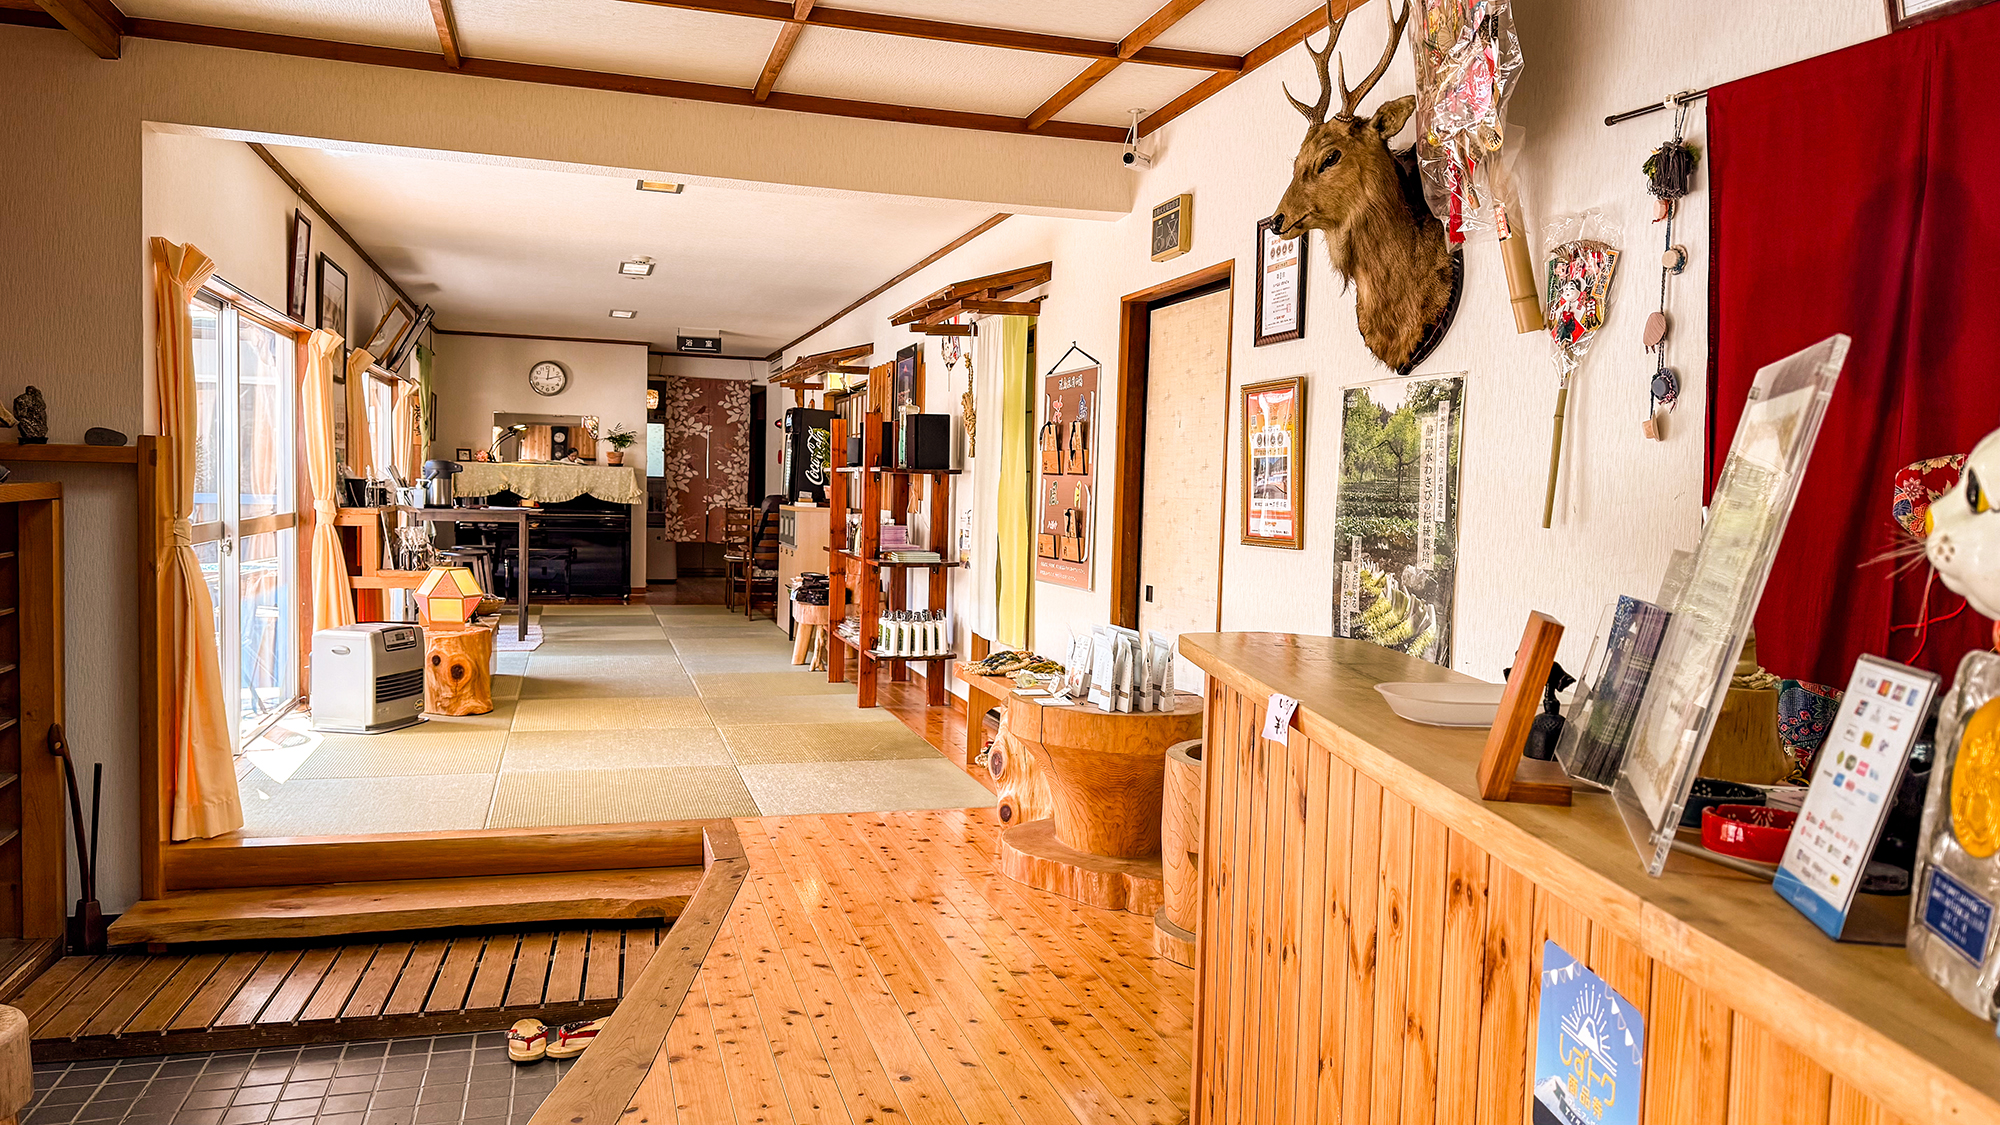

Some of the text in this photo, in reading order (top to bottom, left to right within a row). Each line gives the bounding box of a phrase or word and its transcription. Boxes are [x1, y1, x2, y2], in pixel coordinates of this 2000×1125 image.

[1421, 424, 1434, 564] 静岡水わさびの伝統栽培
[1559, 1033, 1616, 1107] しずトク
[1567, 1072, 1603, 1121] 商品券
